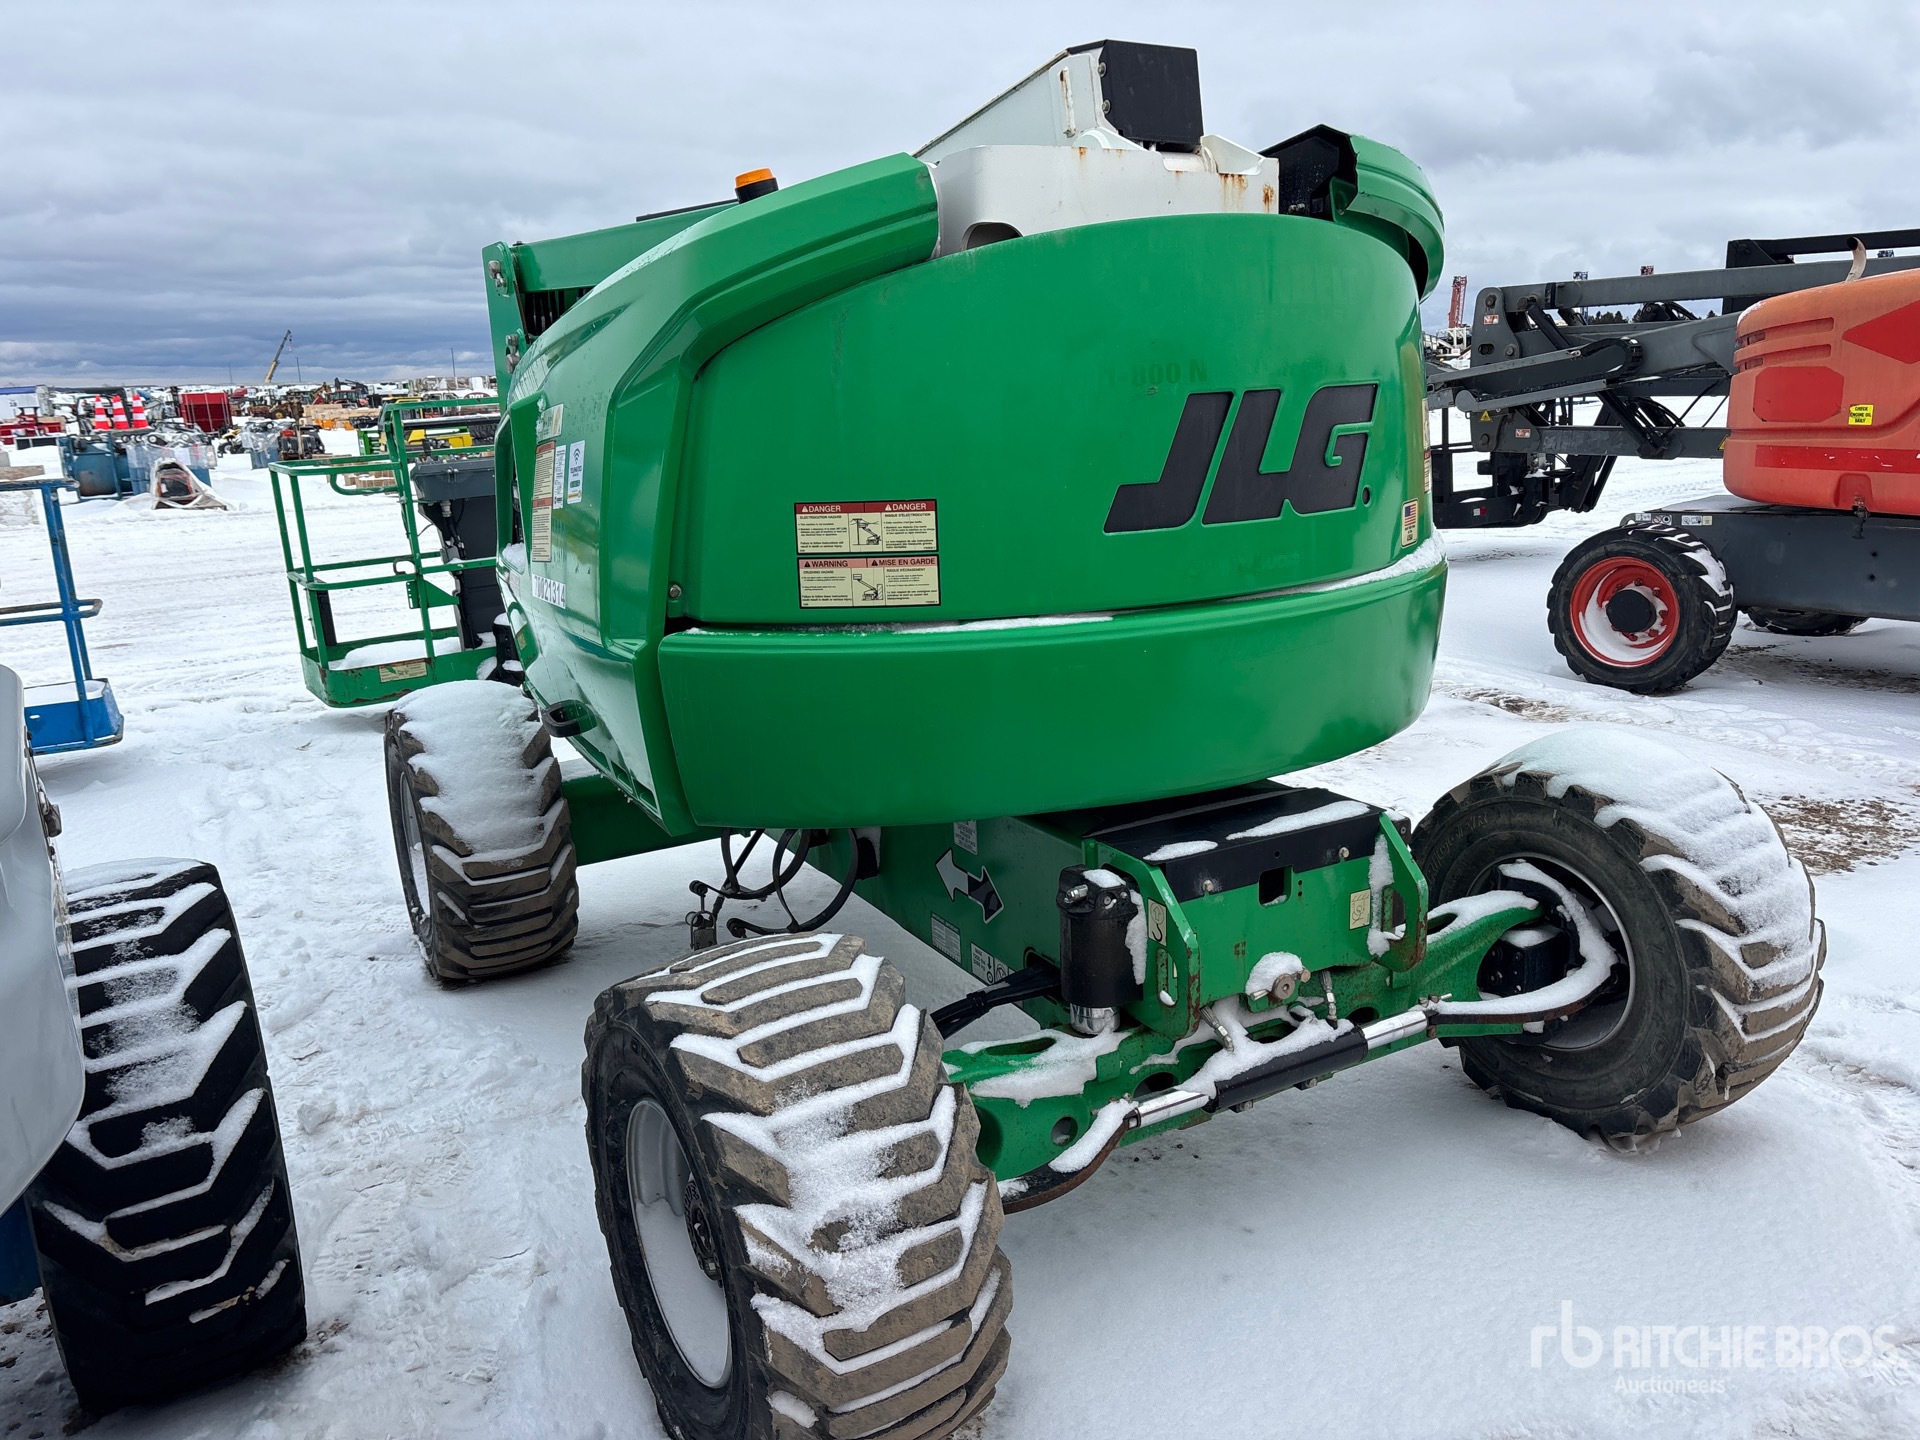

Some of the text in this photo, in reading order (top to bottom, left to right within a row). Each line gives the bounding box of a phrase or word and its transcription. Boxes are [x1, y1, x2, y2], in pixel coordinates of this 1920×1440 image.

[1103, 382, 1379, 535] JLG
[808, 505, 841, 513] DANGER
[892, 503, 927, 511] DANGER
[910, 558, 936, 566] GARDE
